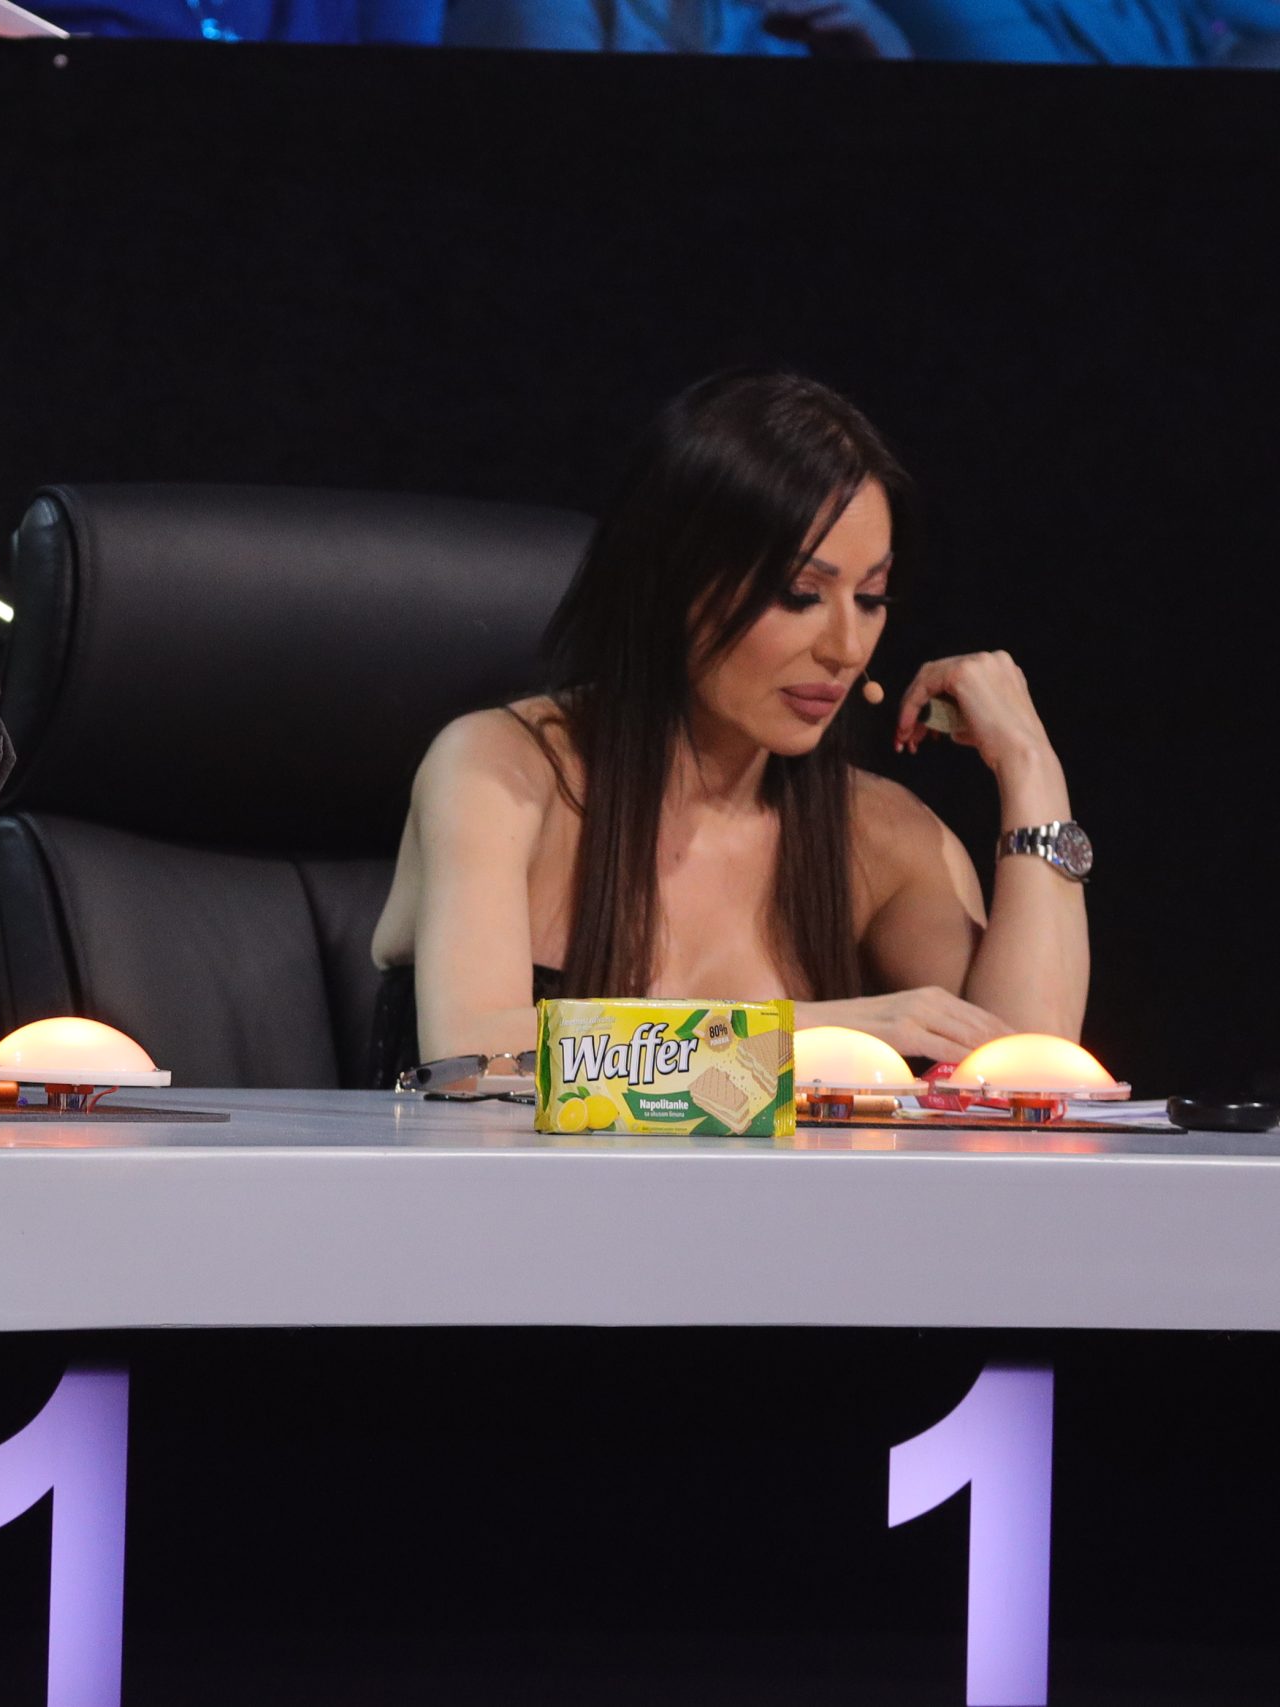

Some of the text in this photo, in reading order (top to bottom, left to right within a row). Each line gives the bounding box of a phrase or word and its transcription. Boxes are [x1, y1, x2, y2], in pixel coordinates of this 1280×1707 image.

[709, 1023, 729, 1039] 80%
[558, 1022, 700, 1086] Waffer
[639, 1098, 689, 1111] Napolitanke
